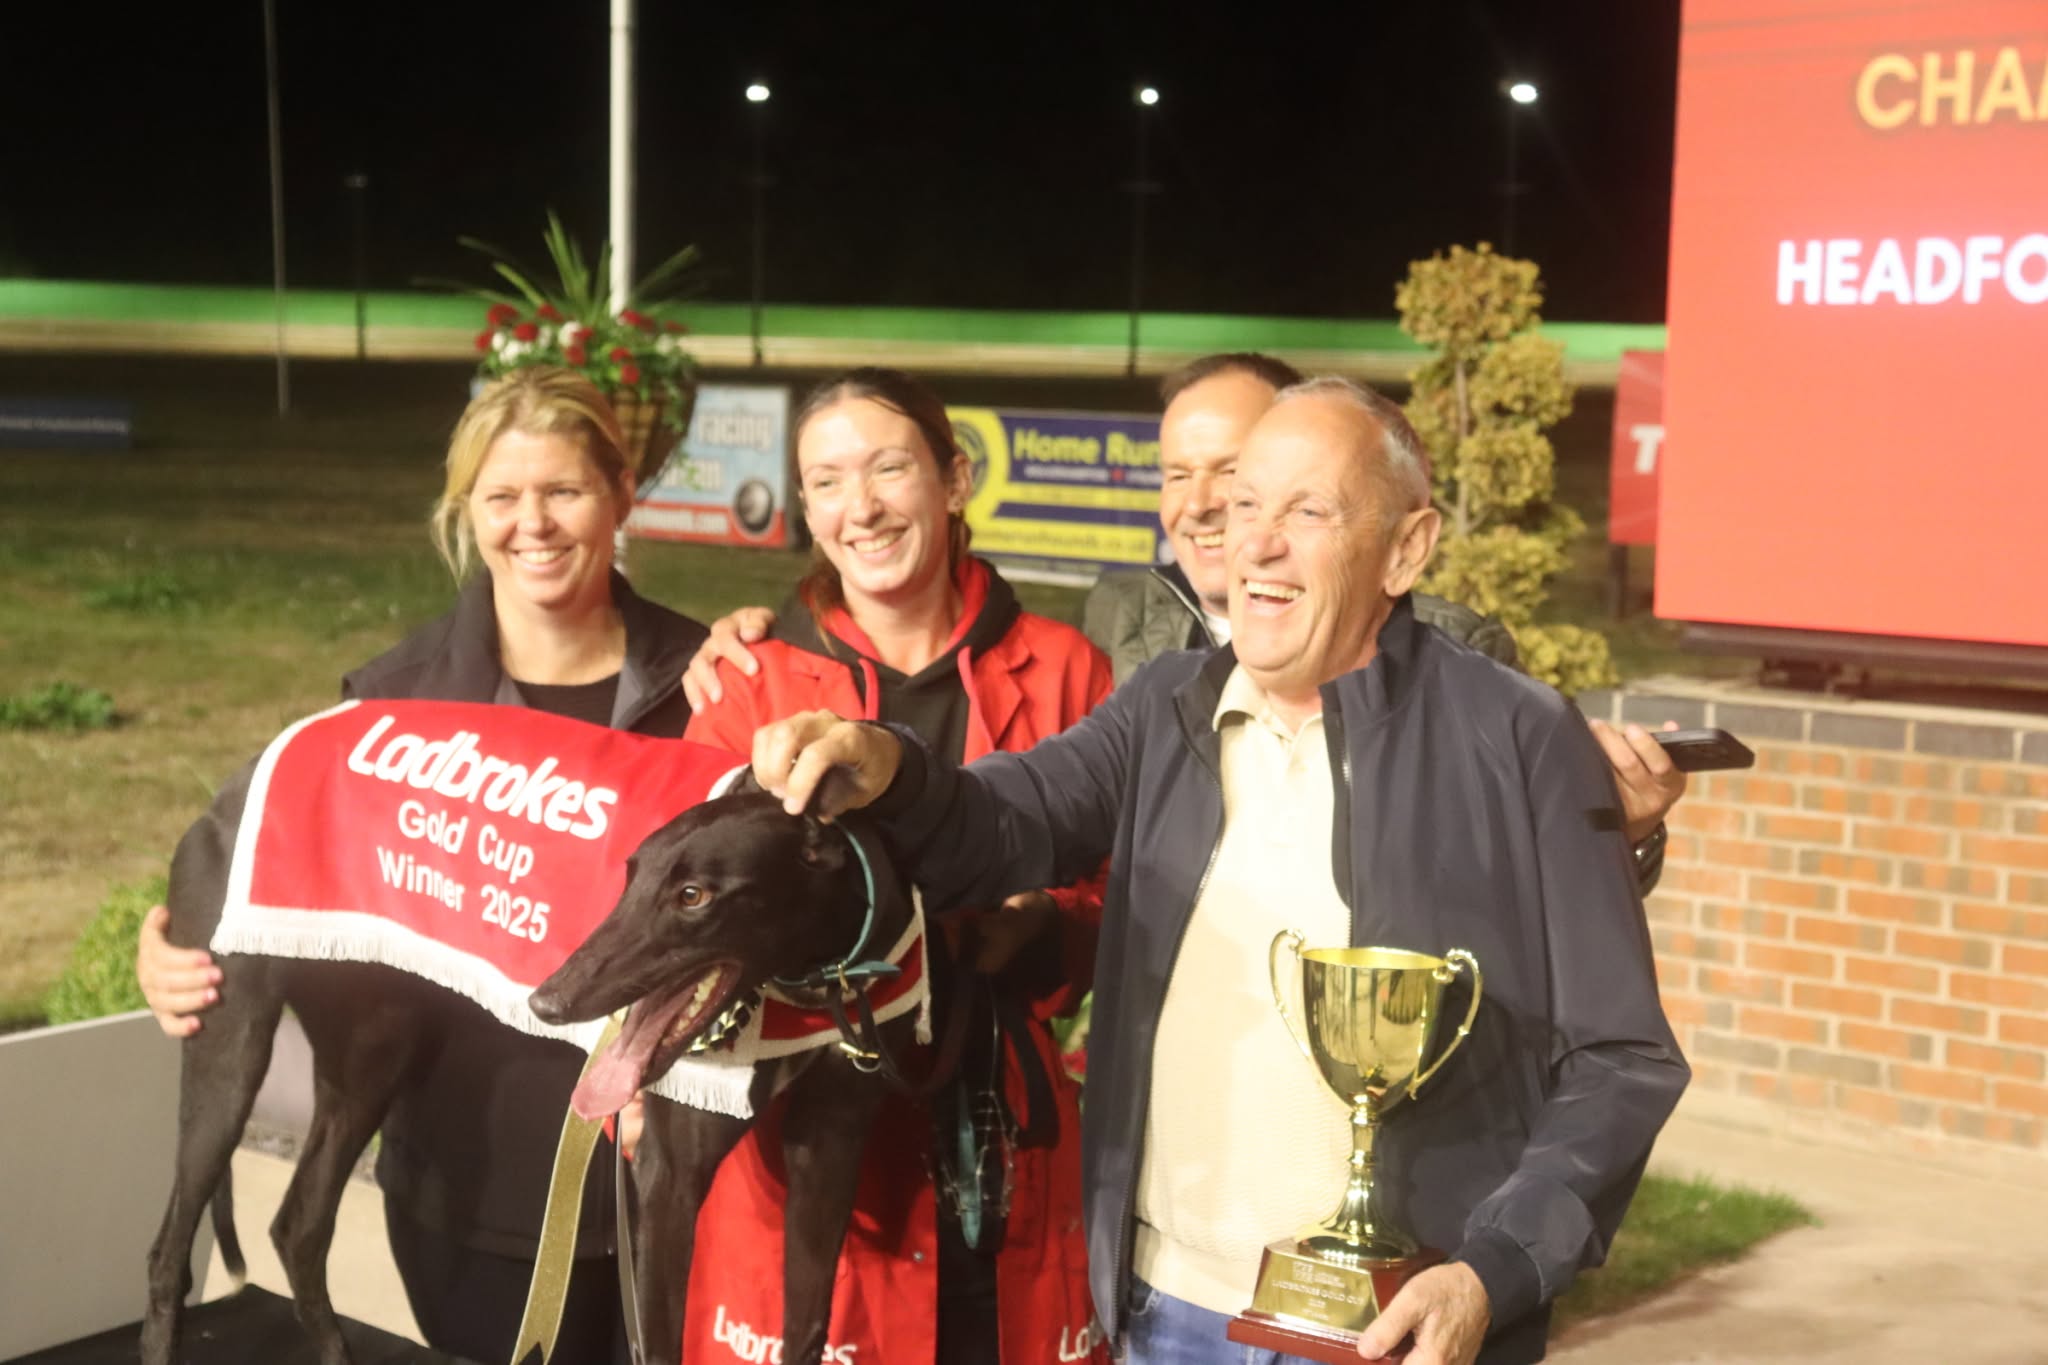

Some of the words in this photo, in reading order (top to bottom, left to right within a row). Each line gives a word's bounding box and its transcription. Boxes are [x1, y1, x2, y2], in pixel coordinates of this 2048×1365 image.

[1855, 46, 2048, 130] CHA
[1013, 428, 1101, 465] Home
[347, 714, 619, 841] Ladbrokes
[397, 799, 470, 855] Gold
[477, 823, 535, 886] Cup
[375, 844, 467, 914] Winner
[479, 883, 551, 944] 2025
